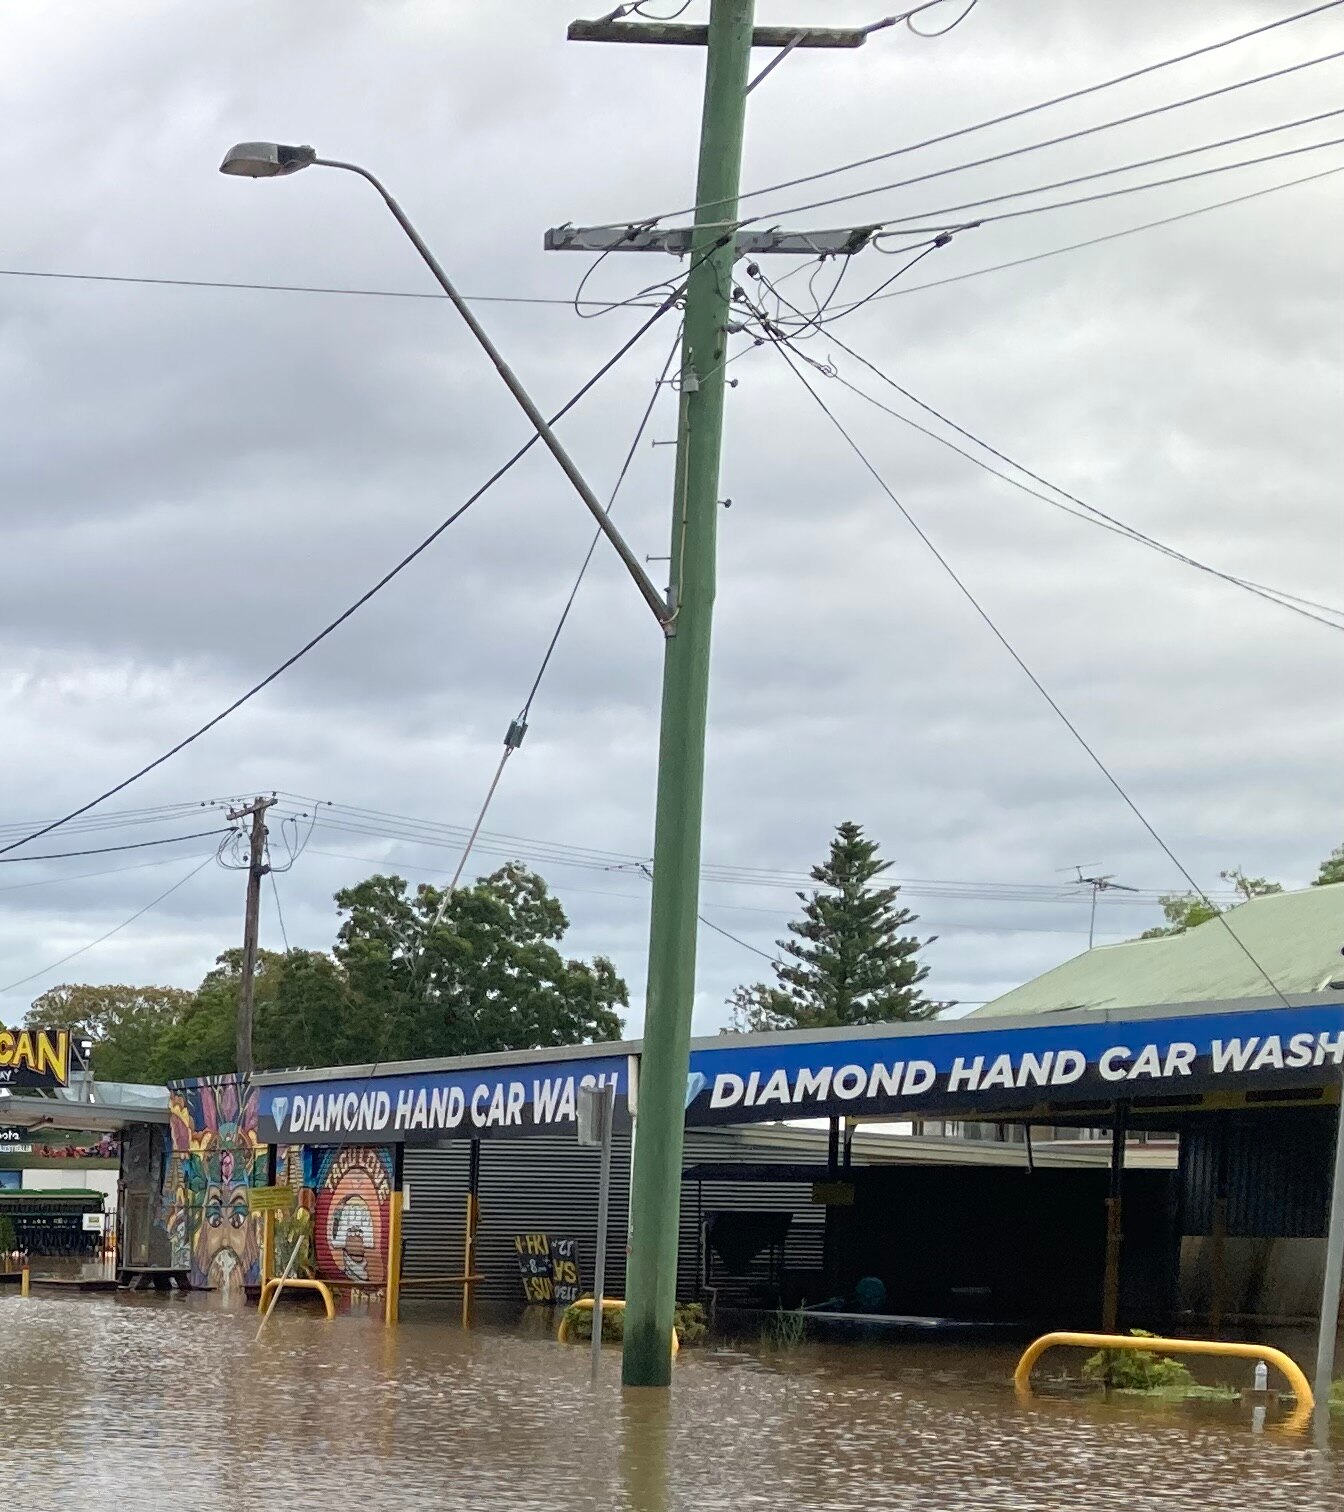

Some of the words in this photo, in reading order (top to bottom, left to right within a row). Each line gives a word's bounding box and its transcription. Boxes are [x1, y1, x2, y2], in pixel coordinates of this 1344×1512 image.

[709, 1059, 937, 1109] DIAMOND
[946, 1050, 1087, 1093] HAND
[1098, 1042, 1198, 1082] CAR
[1211, 1031, 1344, 1074] WASH
[289, 1089, 391, 1133] DIAMOND
[394, 1086, 464, 1130] HAND
[470, 1081, 526, 1128] CAR
